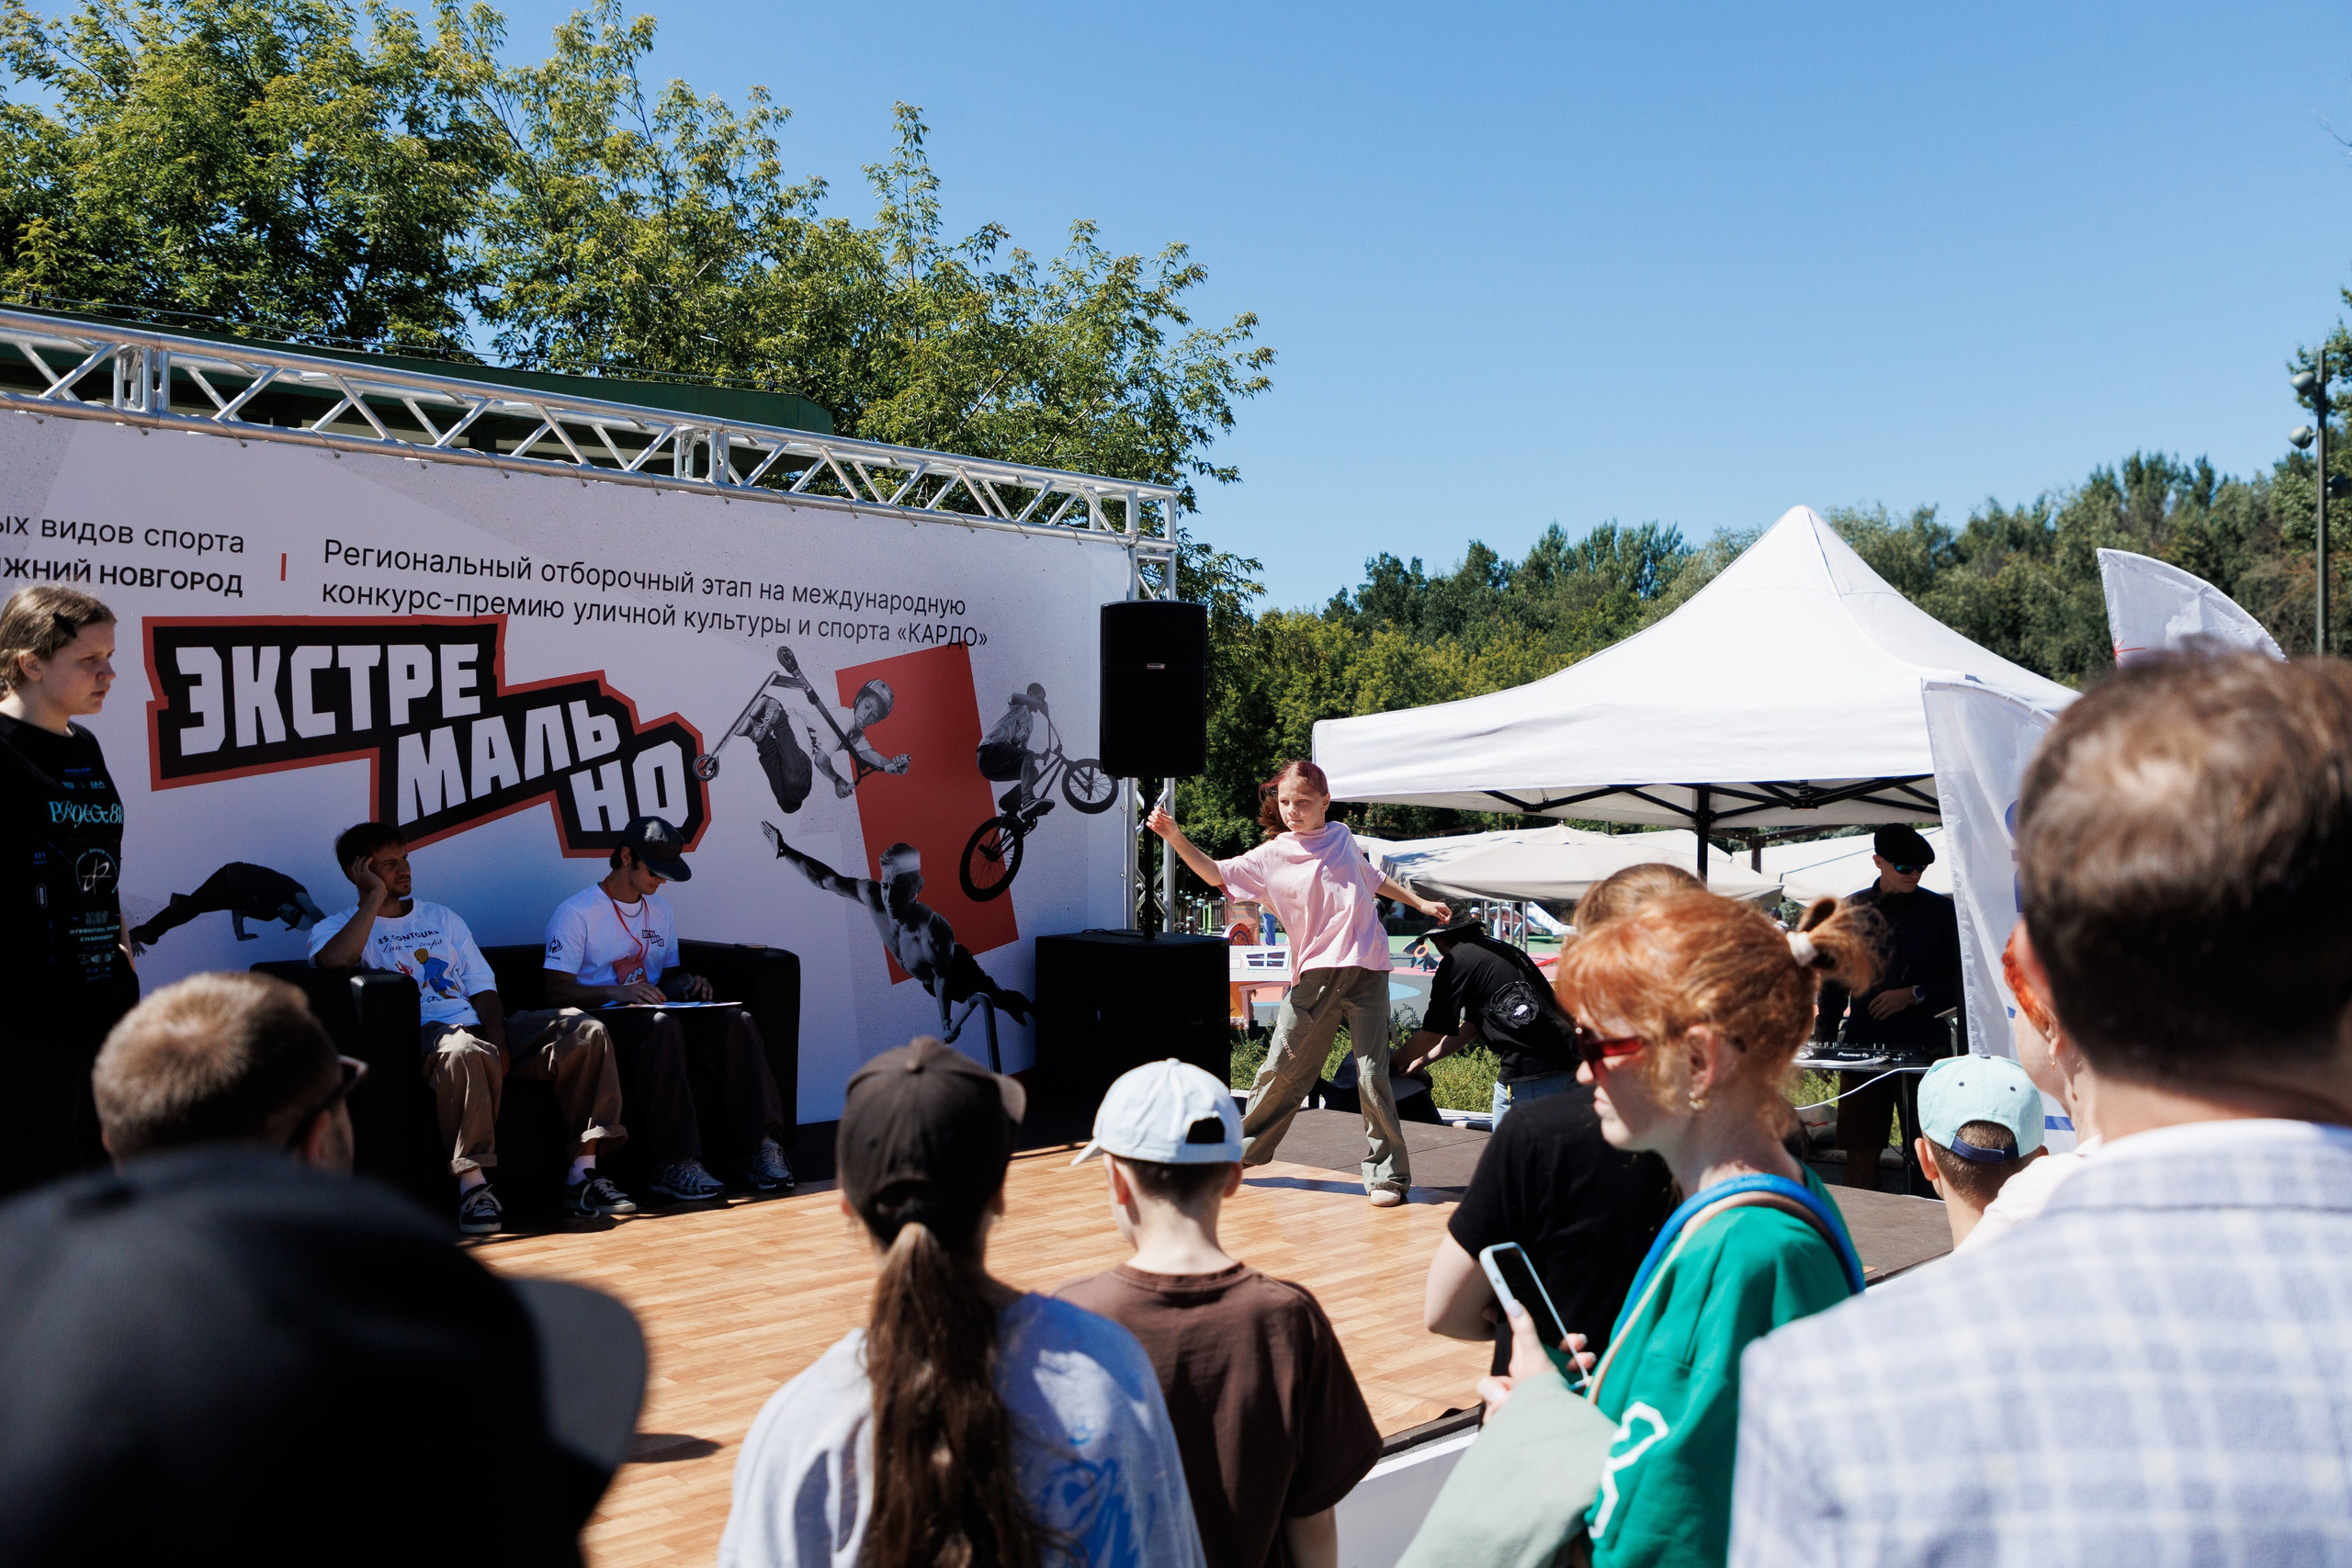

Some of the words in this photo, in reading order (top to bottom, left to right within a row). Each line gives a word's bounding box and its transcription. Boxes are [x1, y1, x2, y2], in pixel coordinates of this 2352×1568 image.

[41, 519, 133, 546] видов
[144, 528, 244, 556] спорта
[99, 565, 243, 598] НОВГОРОД
[324, 539, 531, 580] Региональный
[541, 561, 694, 593] отборочный
[702, 578, 752, 597] этап
[760, 582, 785, 601] на
[792, 585, 966, 618] международную
[322, 583, 565, 618] конкурс-премию
[573, 600, 675, 626] уличной
[684, 610, 790, 637] культуры
[798, 618, 810, 636] и
[818, 620, 890, 644] спорта
[898, 623, 988, 649] «КАРДО»
[175, 643, 481, 756] ЭКСТРЕ
[398, 699, 620, 827] МАЛЬ
[570, 740, 689, 831] НО
[391, 931, 439, 942] CONTOURS
